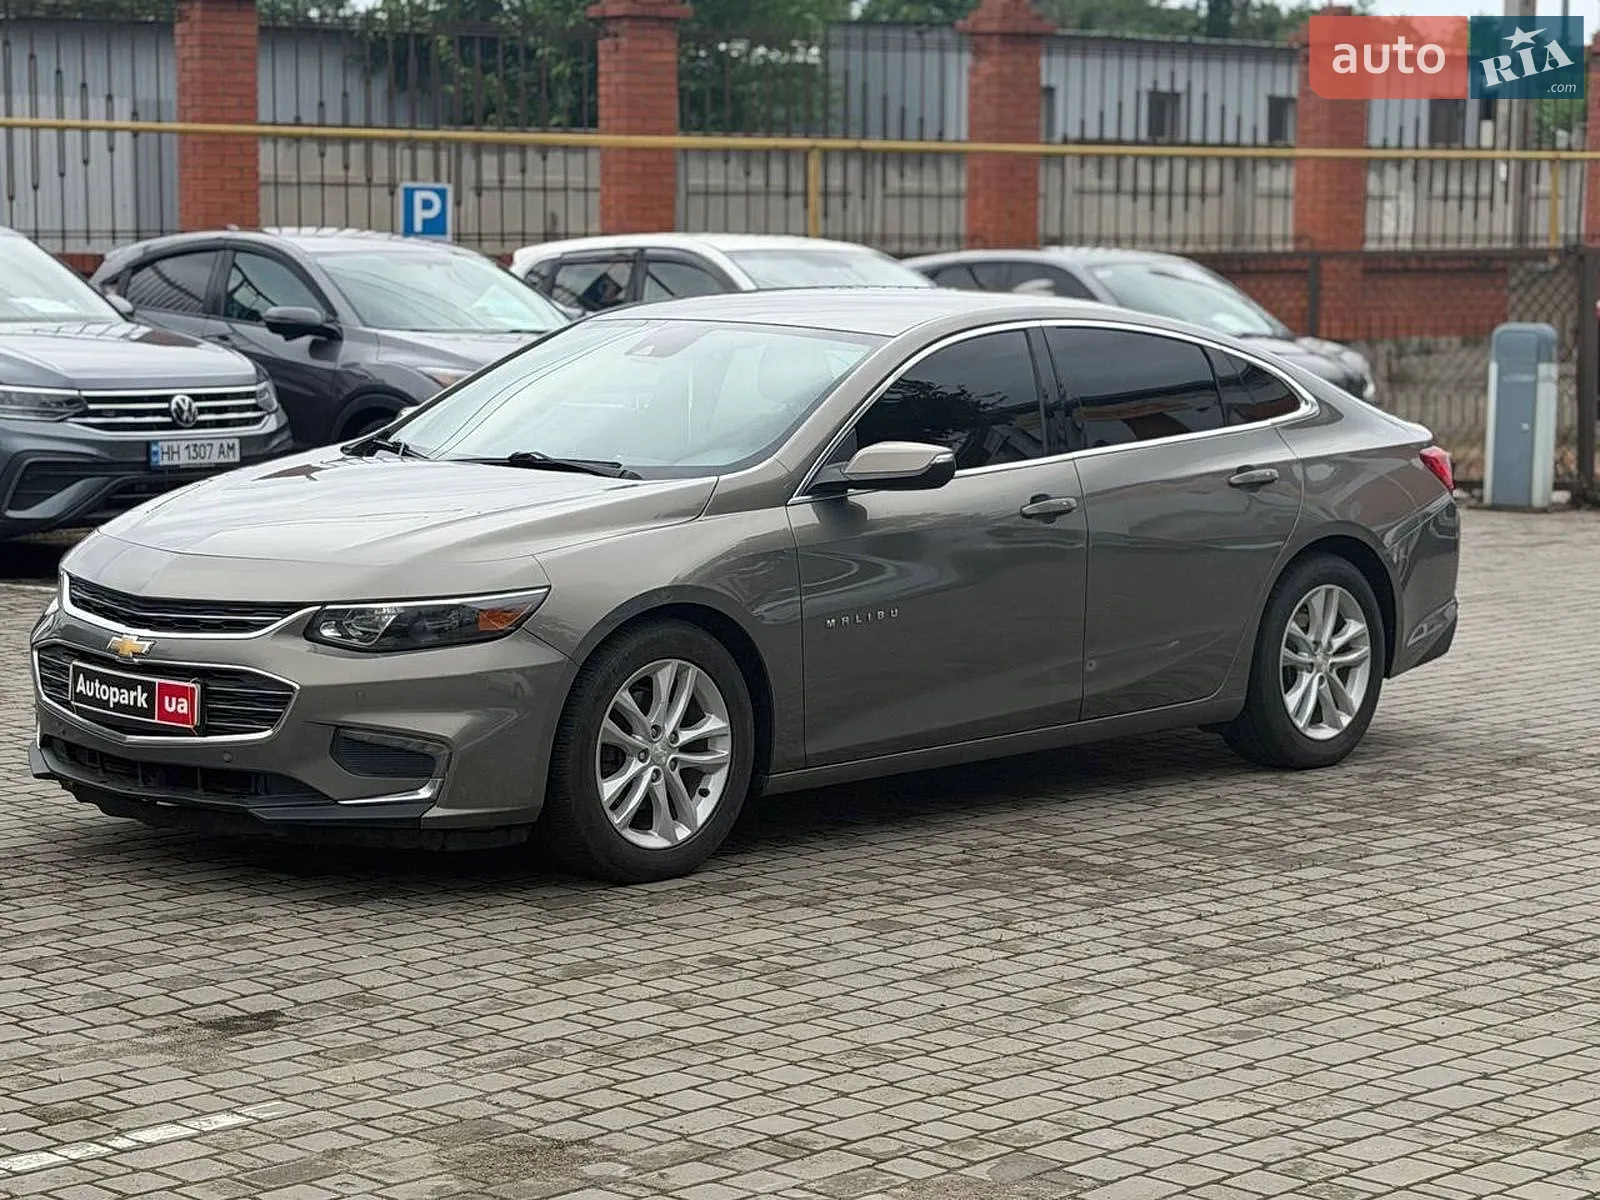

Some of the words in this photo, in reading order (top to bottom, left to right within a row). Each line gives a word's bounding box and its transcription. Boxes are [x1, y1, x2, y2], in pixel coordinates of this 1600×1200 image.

[413, 190, 442, 233] P
[161, 444, 181, 461] HH
[184, 443, 213, 461] 1307
[218, 442, 236, 460] AM
[825, 608, 898, 629] MALIBU
[76, 673, 148, 708] Autopark
[164, 695, 188, 715] ua
